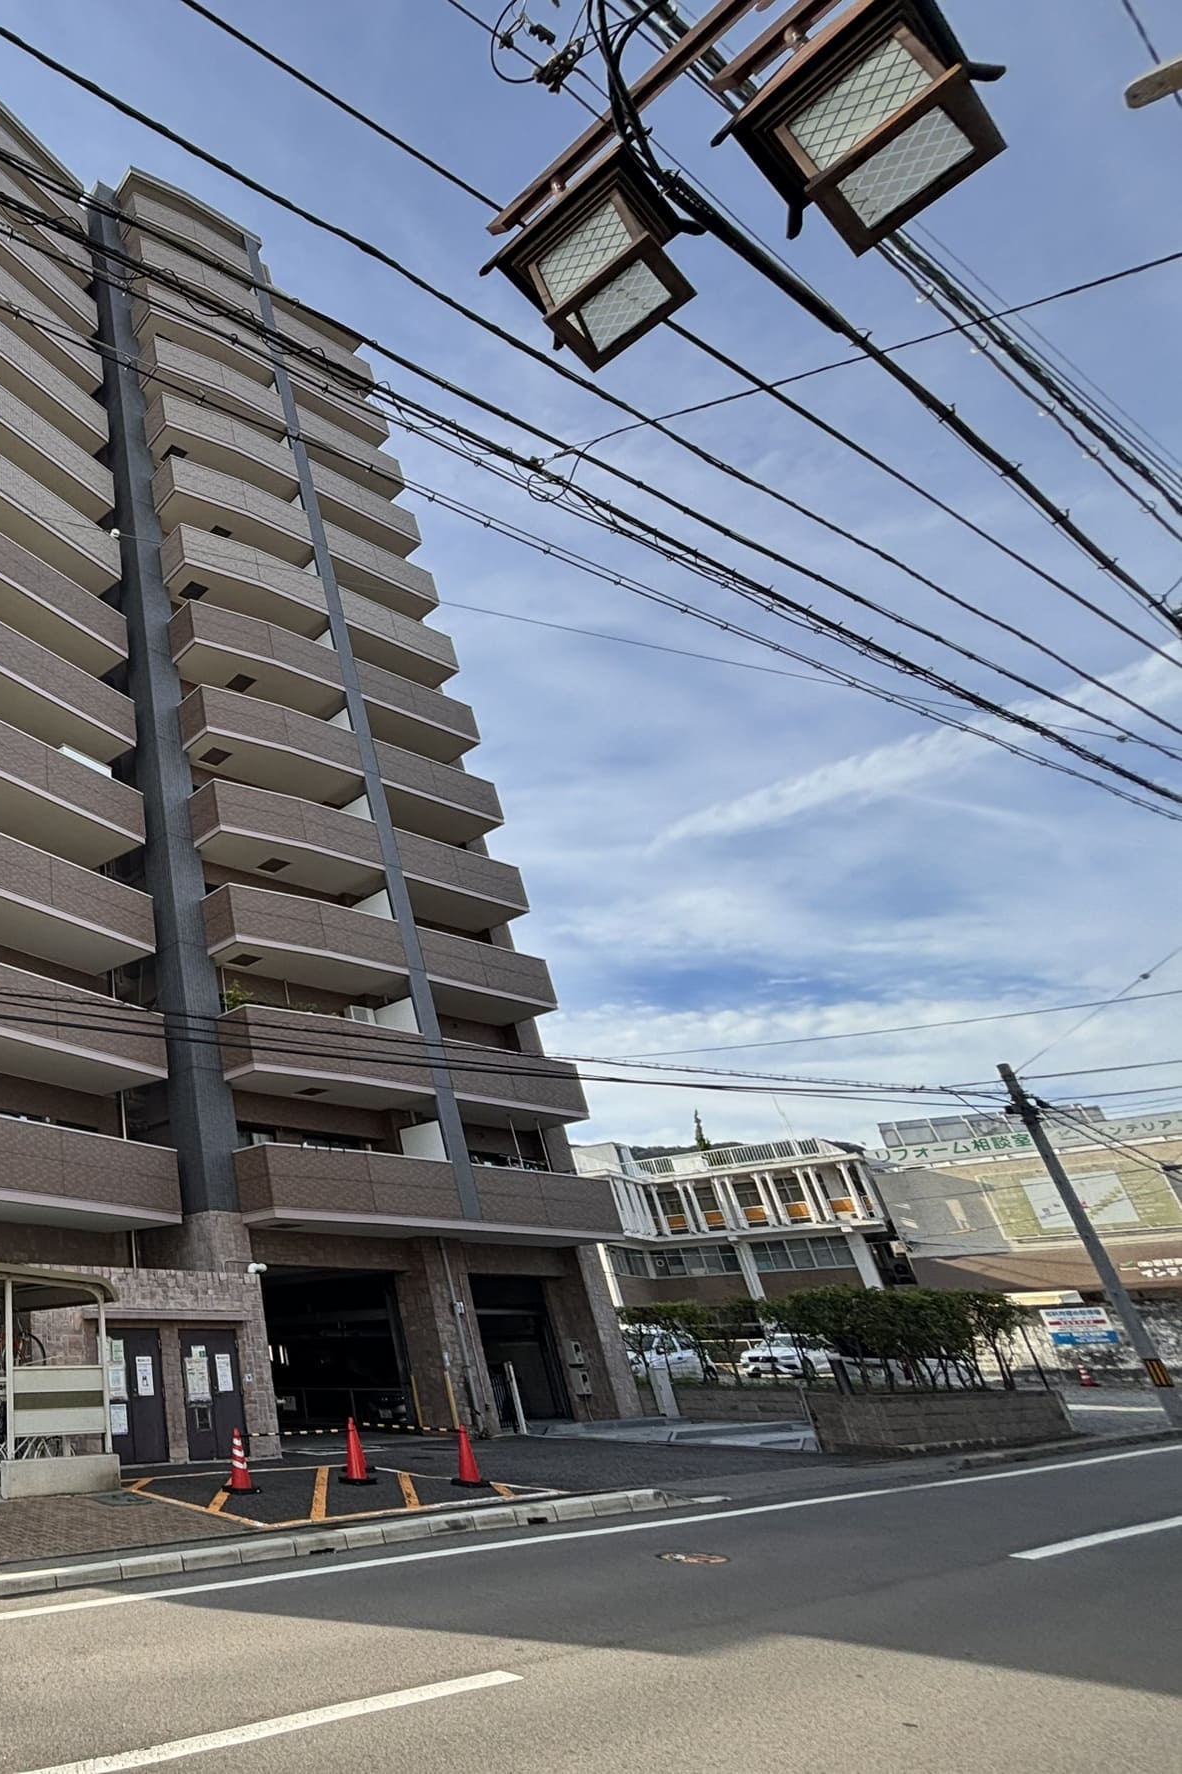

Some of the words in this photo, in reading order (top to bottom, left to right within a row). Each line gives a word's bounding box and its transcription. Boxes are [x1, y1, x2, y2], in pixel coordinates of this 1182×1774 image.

[1093, 1119, 1182, 1135] インテリア
[875, 1133, 1033, 1162] リフォーム相談室
